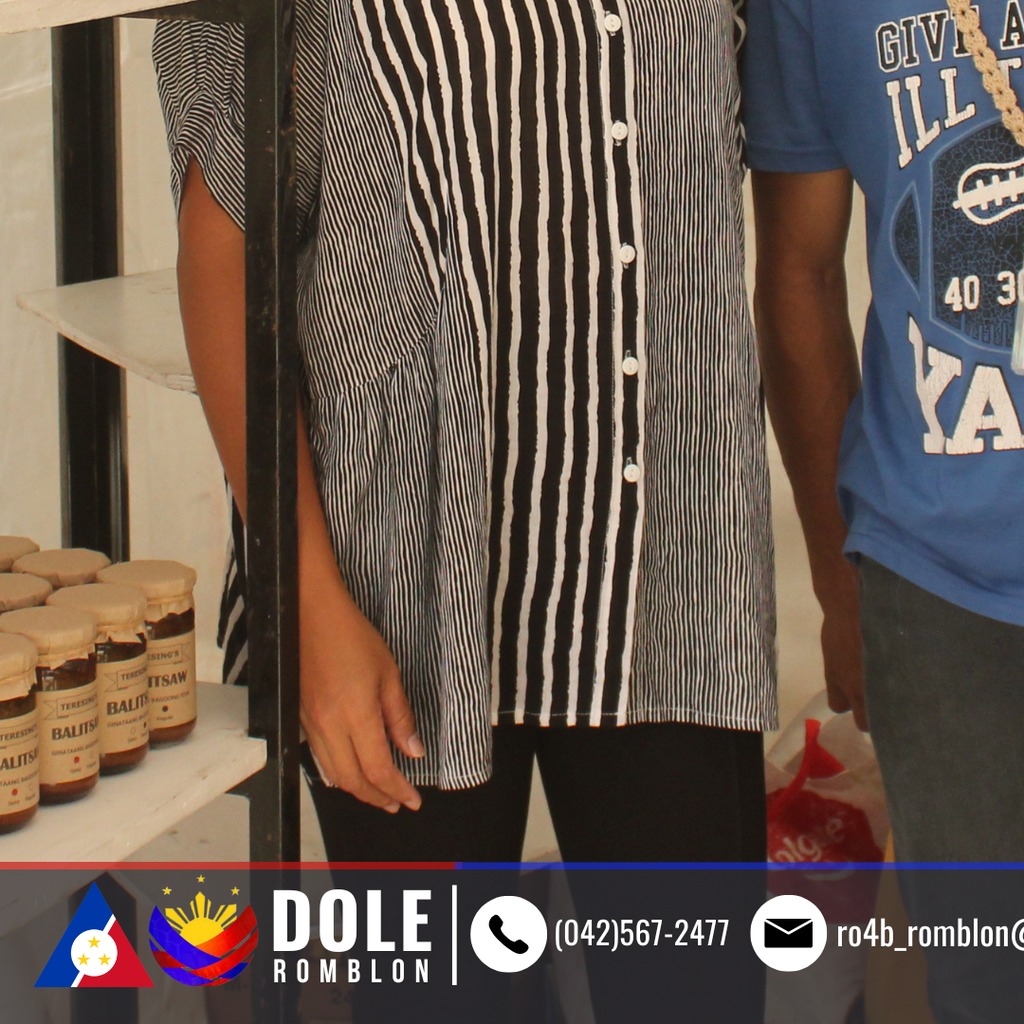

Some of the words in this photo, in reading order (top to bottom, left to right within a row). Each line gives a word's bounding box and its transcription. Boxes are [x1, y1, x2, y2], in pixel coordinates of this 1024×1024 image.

[886, 67, 977, 169] ILL
[944, 275, 980, 312] 40
[147, 669, 187, 688] ITSAW
